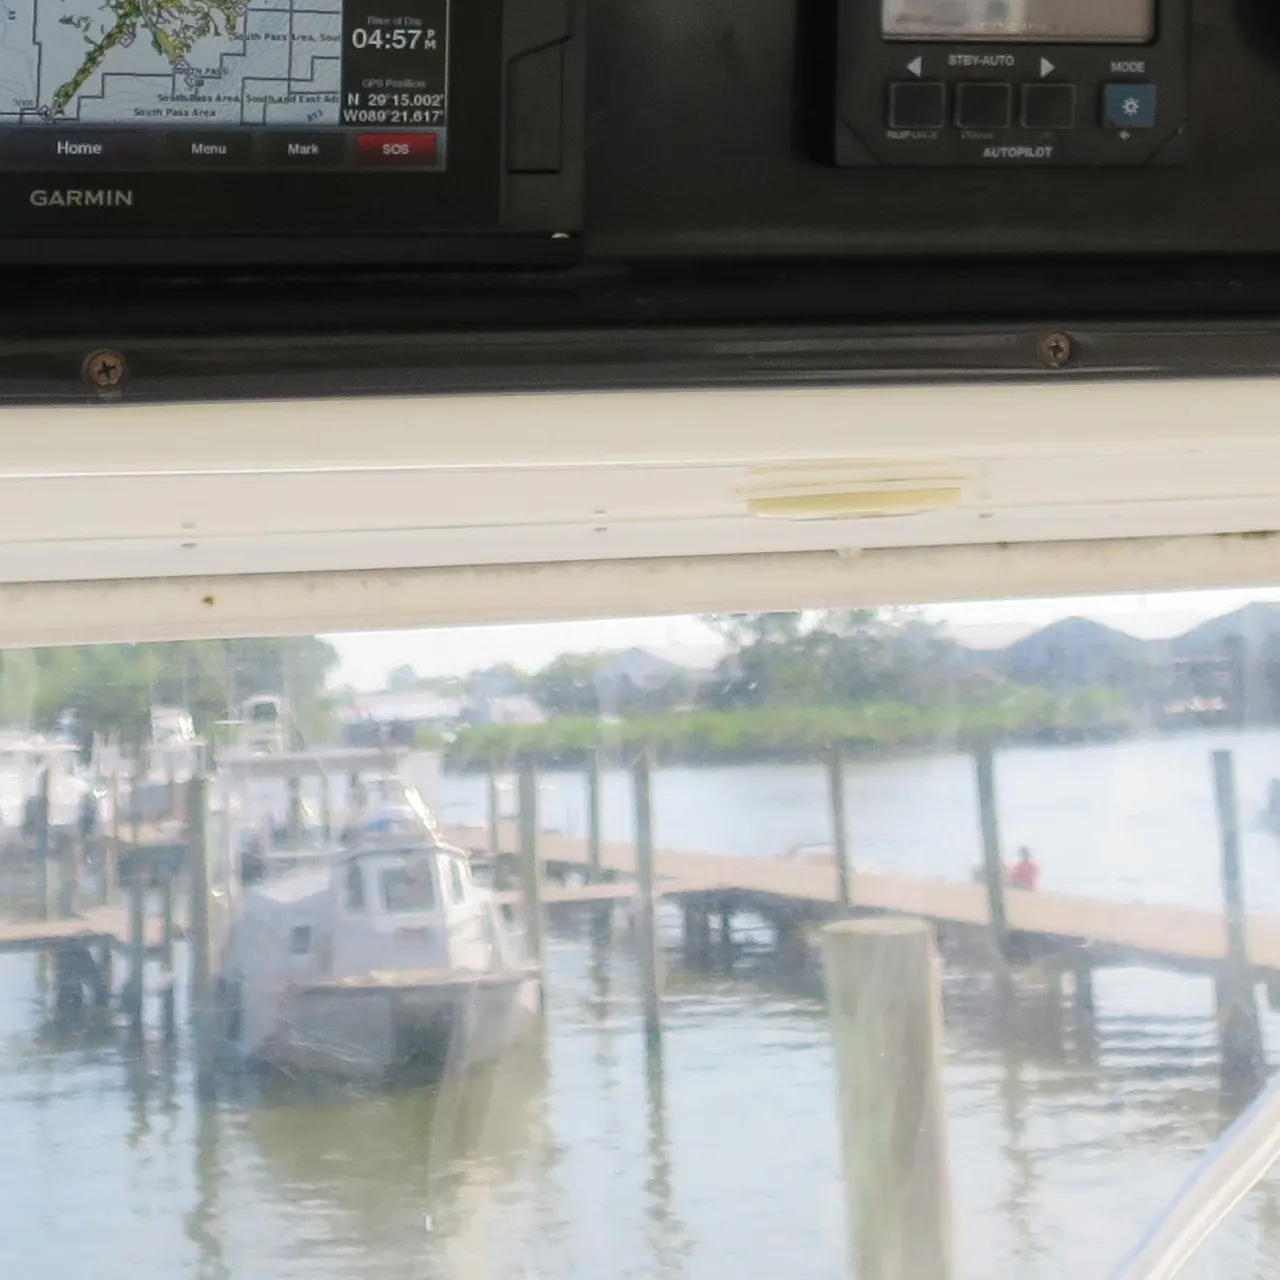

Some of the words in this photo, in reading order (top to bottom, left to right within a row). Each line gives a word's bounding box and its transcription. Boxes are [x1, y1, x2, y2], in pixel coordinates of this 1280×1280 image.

[264, 33, 287, 41] Pass
[352, 28, 422, 50] 04:57
[1110, 61, 1145, 73] MODE
[347, 92, 360, 107] N
[133, 107, 163, 117] South
[166, 108, 189, 118] Pass
[192, 108, 216, 118] Area
[56, 140, 102, 156] Home
[191, 142, 227, 155] Menu
[287, 142, 319, 155] Mark
[381, 142, 410, 156] SOS
[982, 146, 1053, 159] AUTOPILOT
[30, 189, 133, 207] GARMIN
